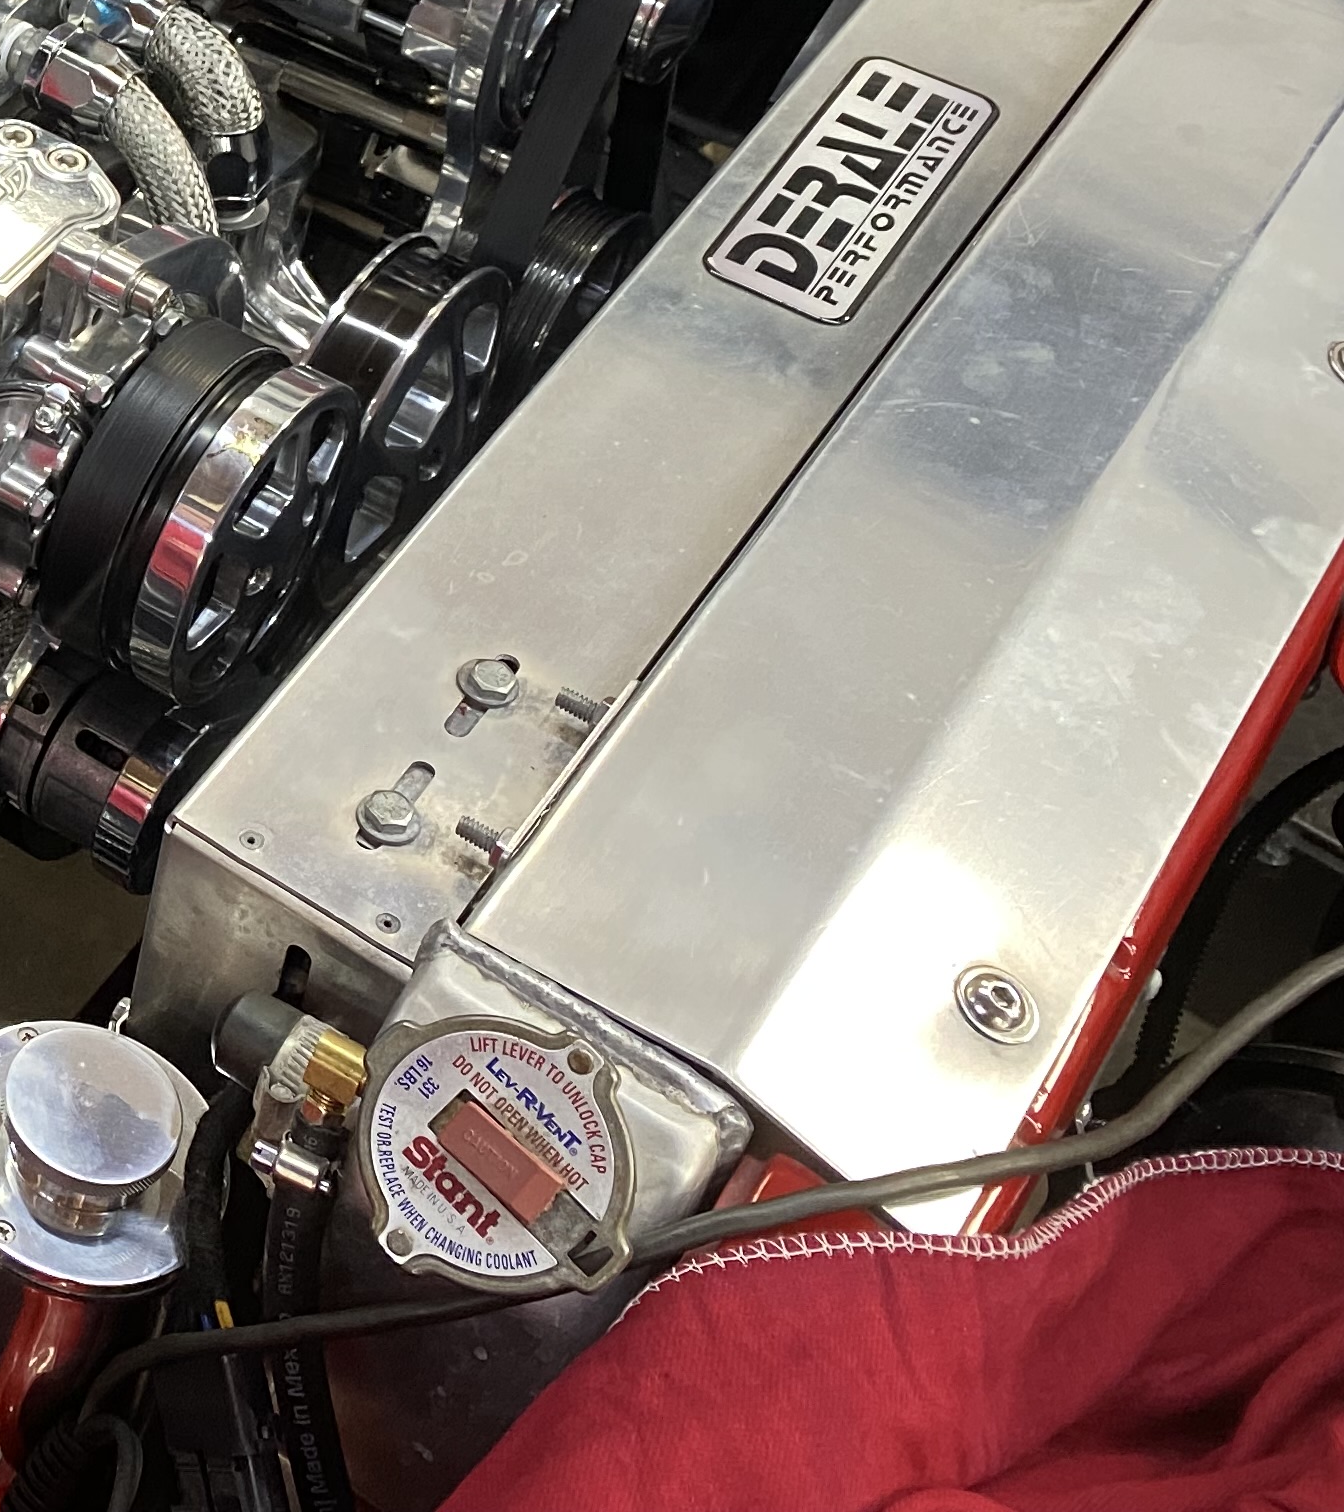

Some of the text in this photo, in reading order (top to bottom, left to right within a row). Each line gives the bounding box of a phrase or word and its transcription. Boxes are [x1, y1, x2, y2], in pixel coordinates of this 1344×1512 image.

[725, 70, 950, 293] DERALE
[813, 100, 979, 306] PERFORMANCE
[416, 1054, 434, 1072] 16
[418, 1076, 441, 1100] 331
[469, 1035, 608, 1176] LIFT LEVER TO UNLOCK CAP
[452, 1053, 590, 1193] DO NOT OPEN WHEN HOT
[376, 1103, 539, 1271] TEST OR REPLACE WHEN CHANGING COOLANT
[401, 1166, 429, 1191] MADE
[426, 1189, 439, 1205] IN
[401, 1135, 502, 1239] Stant
[293, 1405, 311, 1425] in
[300, 1433, 329, 1494] Made
